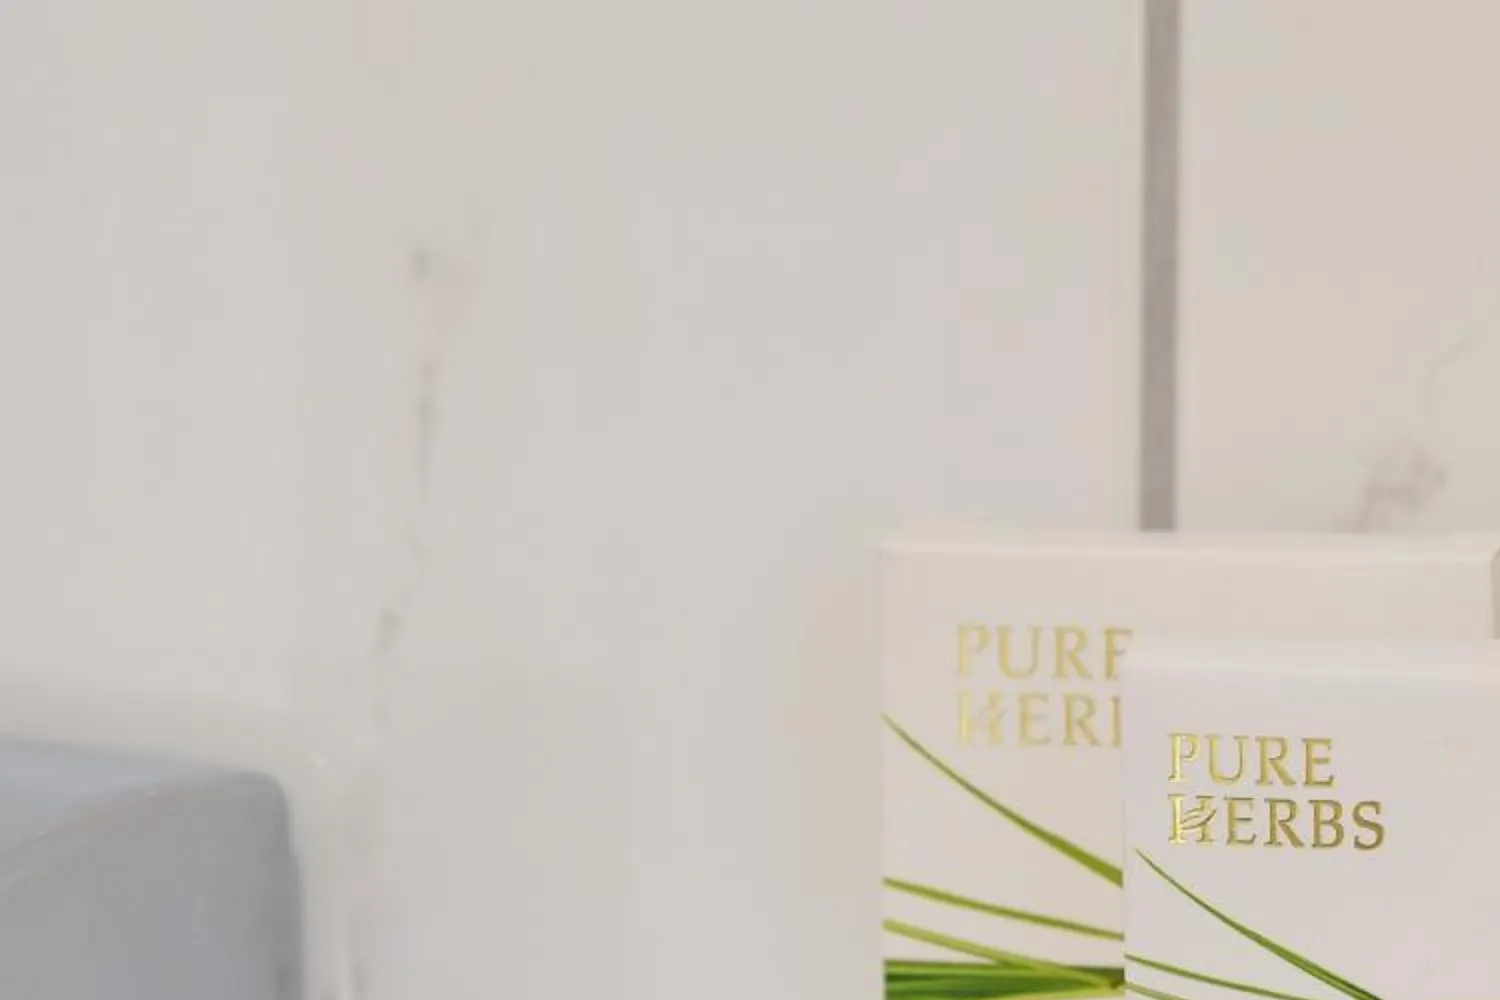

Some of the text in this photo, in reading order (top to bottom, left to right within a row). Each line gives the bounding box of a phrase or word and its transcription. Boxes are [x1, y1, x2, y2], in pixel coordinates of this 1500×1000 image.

[954, 622, 1133, 682] PURE
[1166, 731, 1336, 789] PURE
[1166, 793, 1386, 853] HERBS
